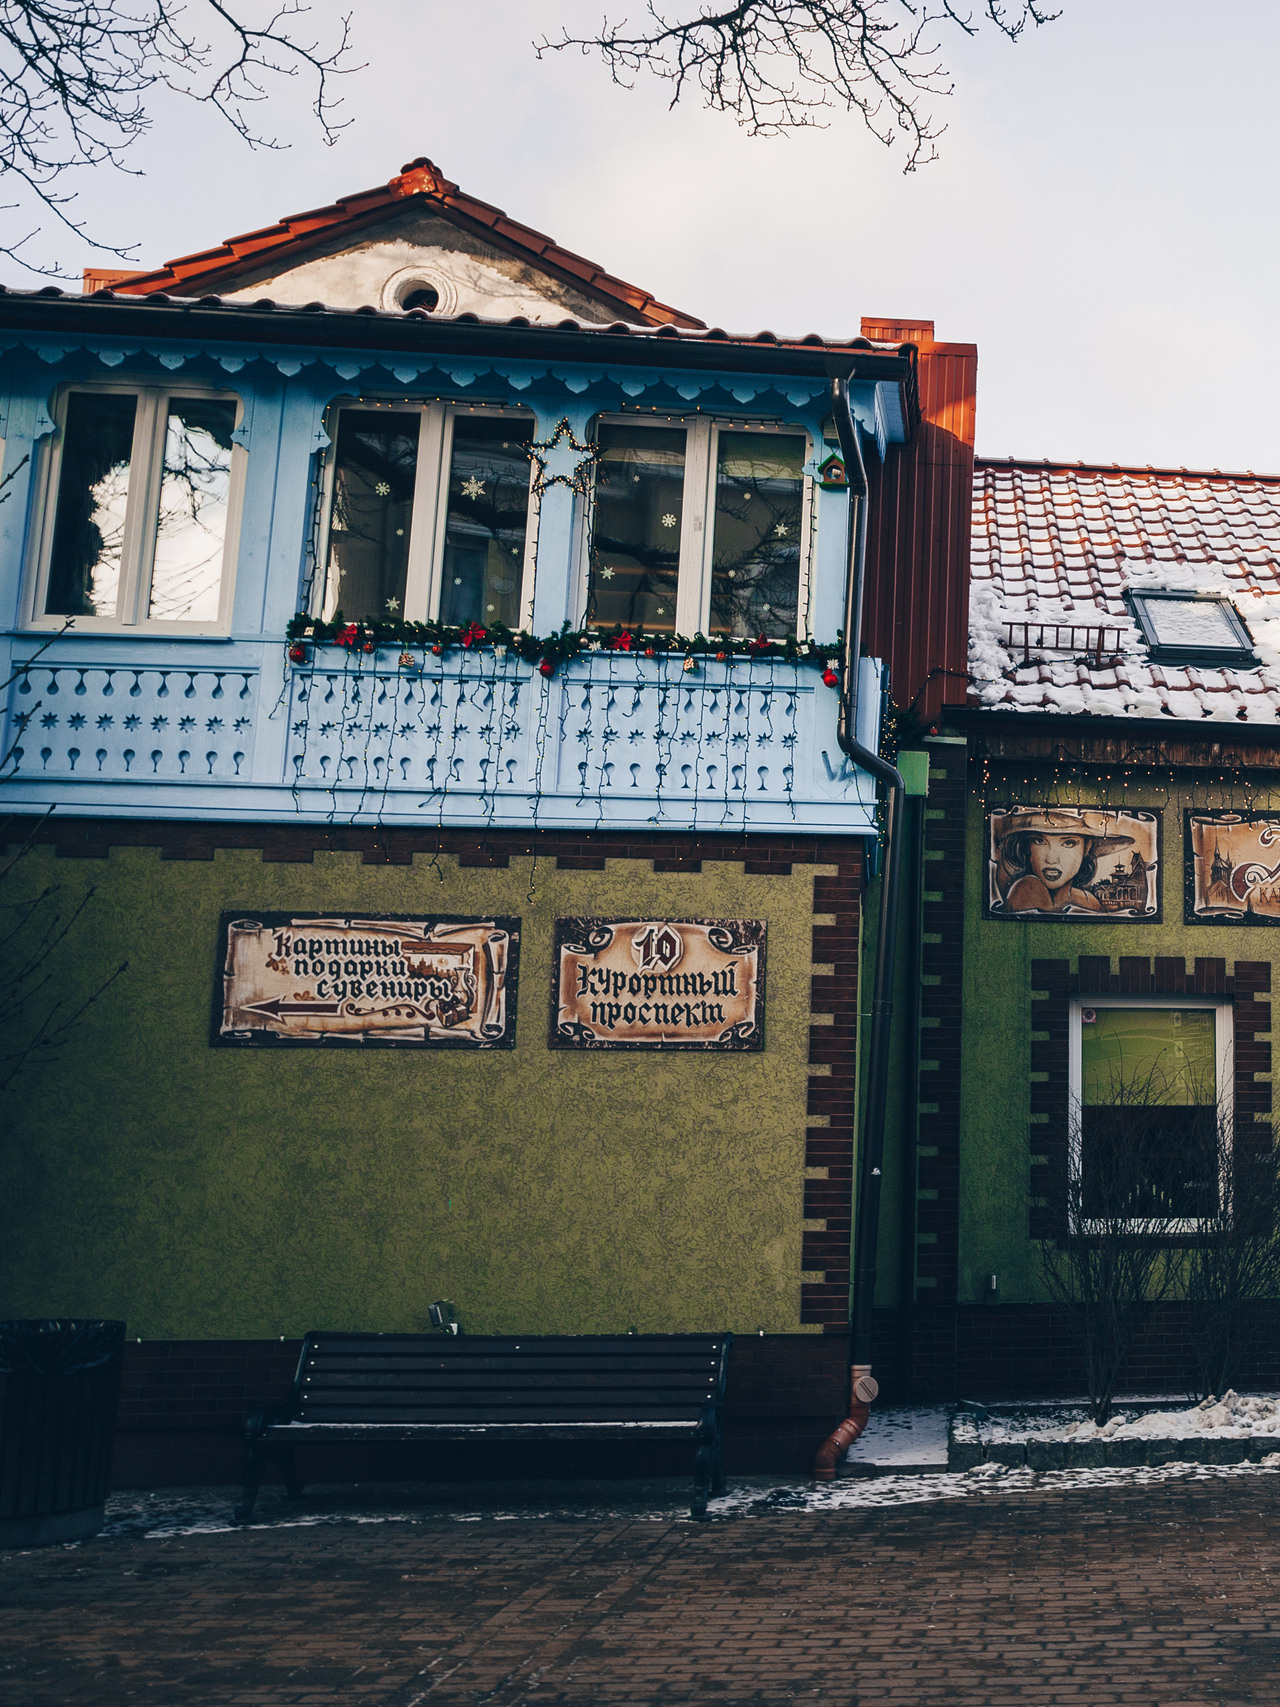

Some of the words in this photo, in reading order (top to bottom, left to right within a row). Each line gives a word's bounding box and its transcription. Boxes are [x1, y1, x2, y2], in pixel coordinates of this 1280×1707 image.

[274, 932, 402, 960] Картины
[633, 926, 681, 971] 10
[293, 957, 408, 982] подарки
[576, 961, 740, 999] Курортный
[316, 978, 451, 1003] сувениры
[590, 1000, 726, 1030] проспект
